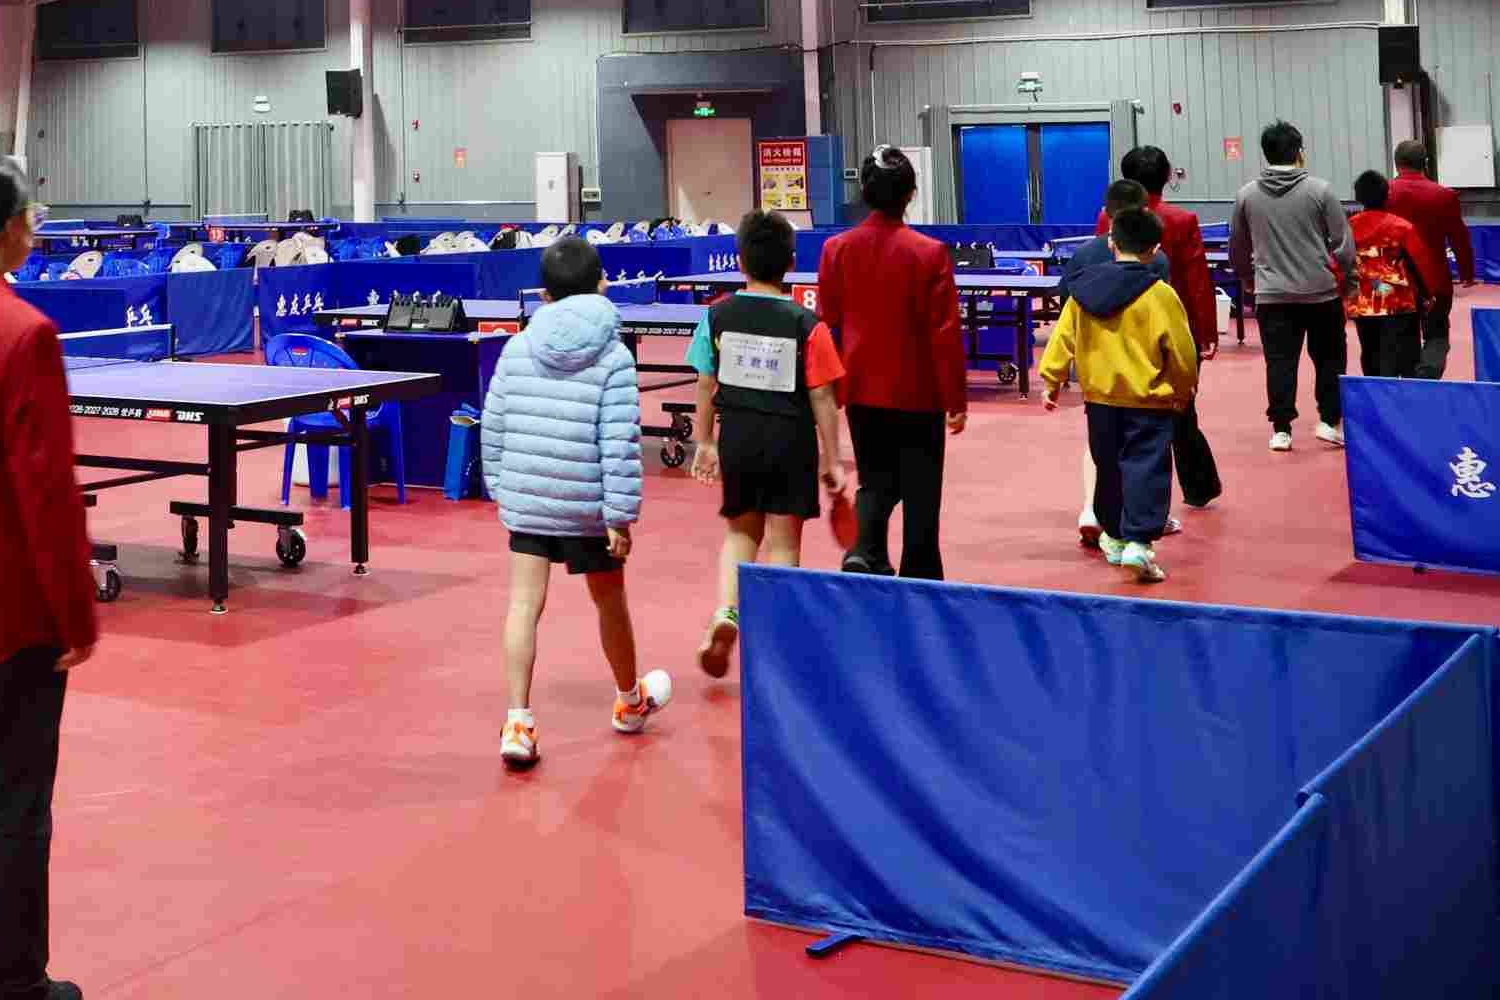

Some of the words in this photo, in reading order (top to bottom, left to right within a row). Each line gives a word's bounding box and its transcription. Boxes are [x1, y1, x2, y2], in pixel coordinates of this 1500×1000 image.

[803, 289, 817, 310] 8
[175, 410, 205, 422] DHS
[1449, 446, 1497, 498] 惠
